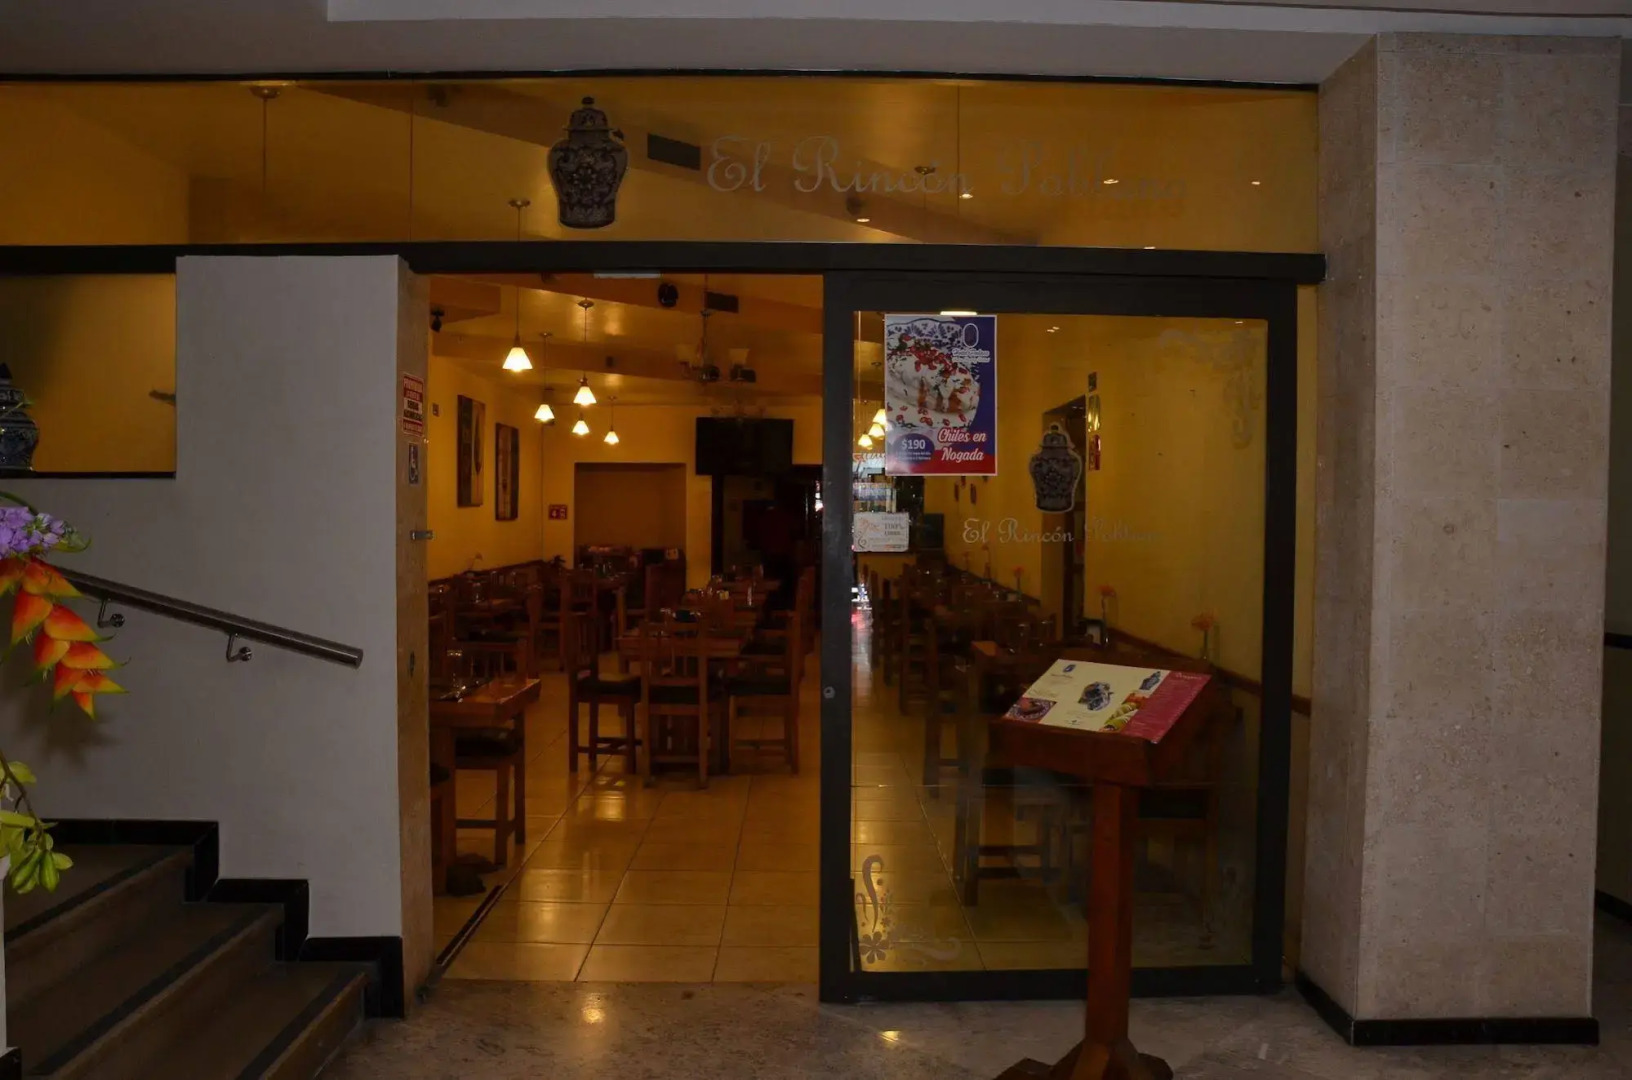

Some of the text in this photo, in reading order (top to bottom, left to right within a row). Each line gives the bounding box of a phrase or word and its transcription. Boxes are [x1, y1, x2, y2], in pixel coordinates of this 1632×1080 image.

[706, 134, 773, 194] El
[792, 134, 973, 194] Rincón
[938, 428, 986, 442] Chiles en
[901, 439, 926, 450] $190
[941, 447, 984, 463] Nogada
[962, 518, 990, 543] El
[999, 517, 1074, 543] Rincón
